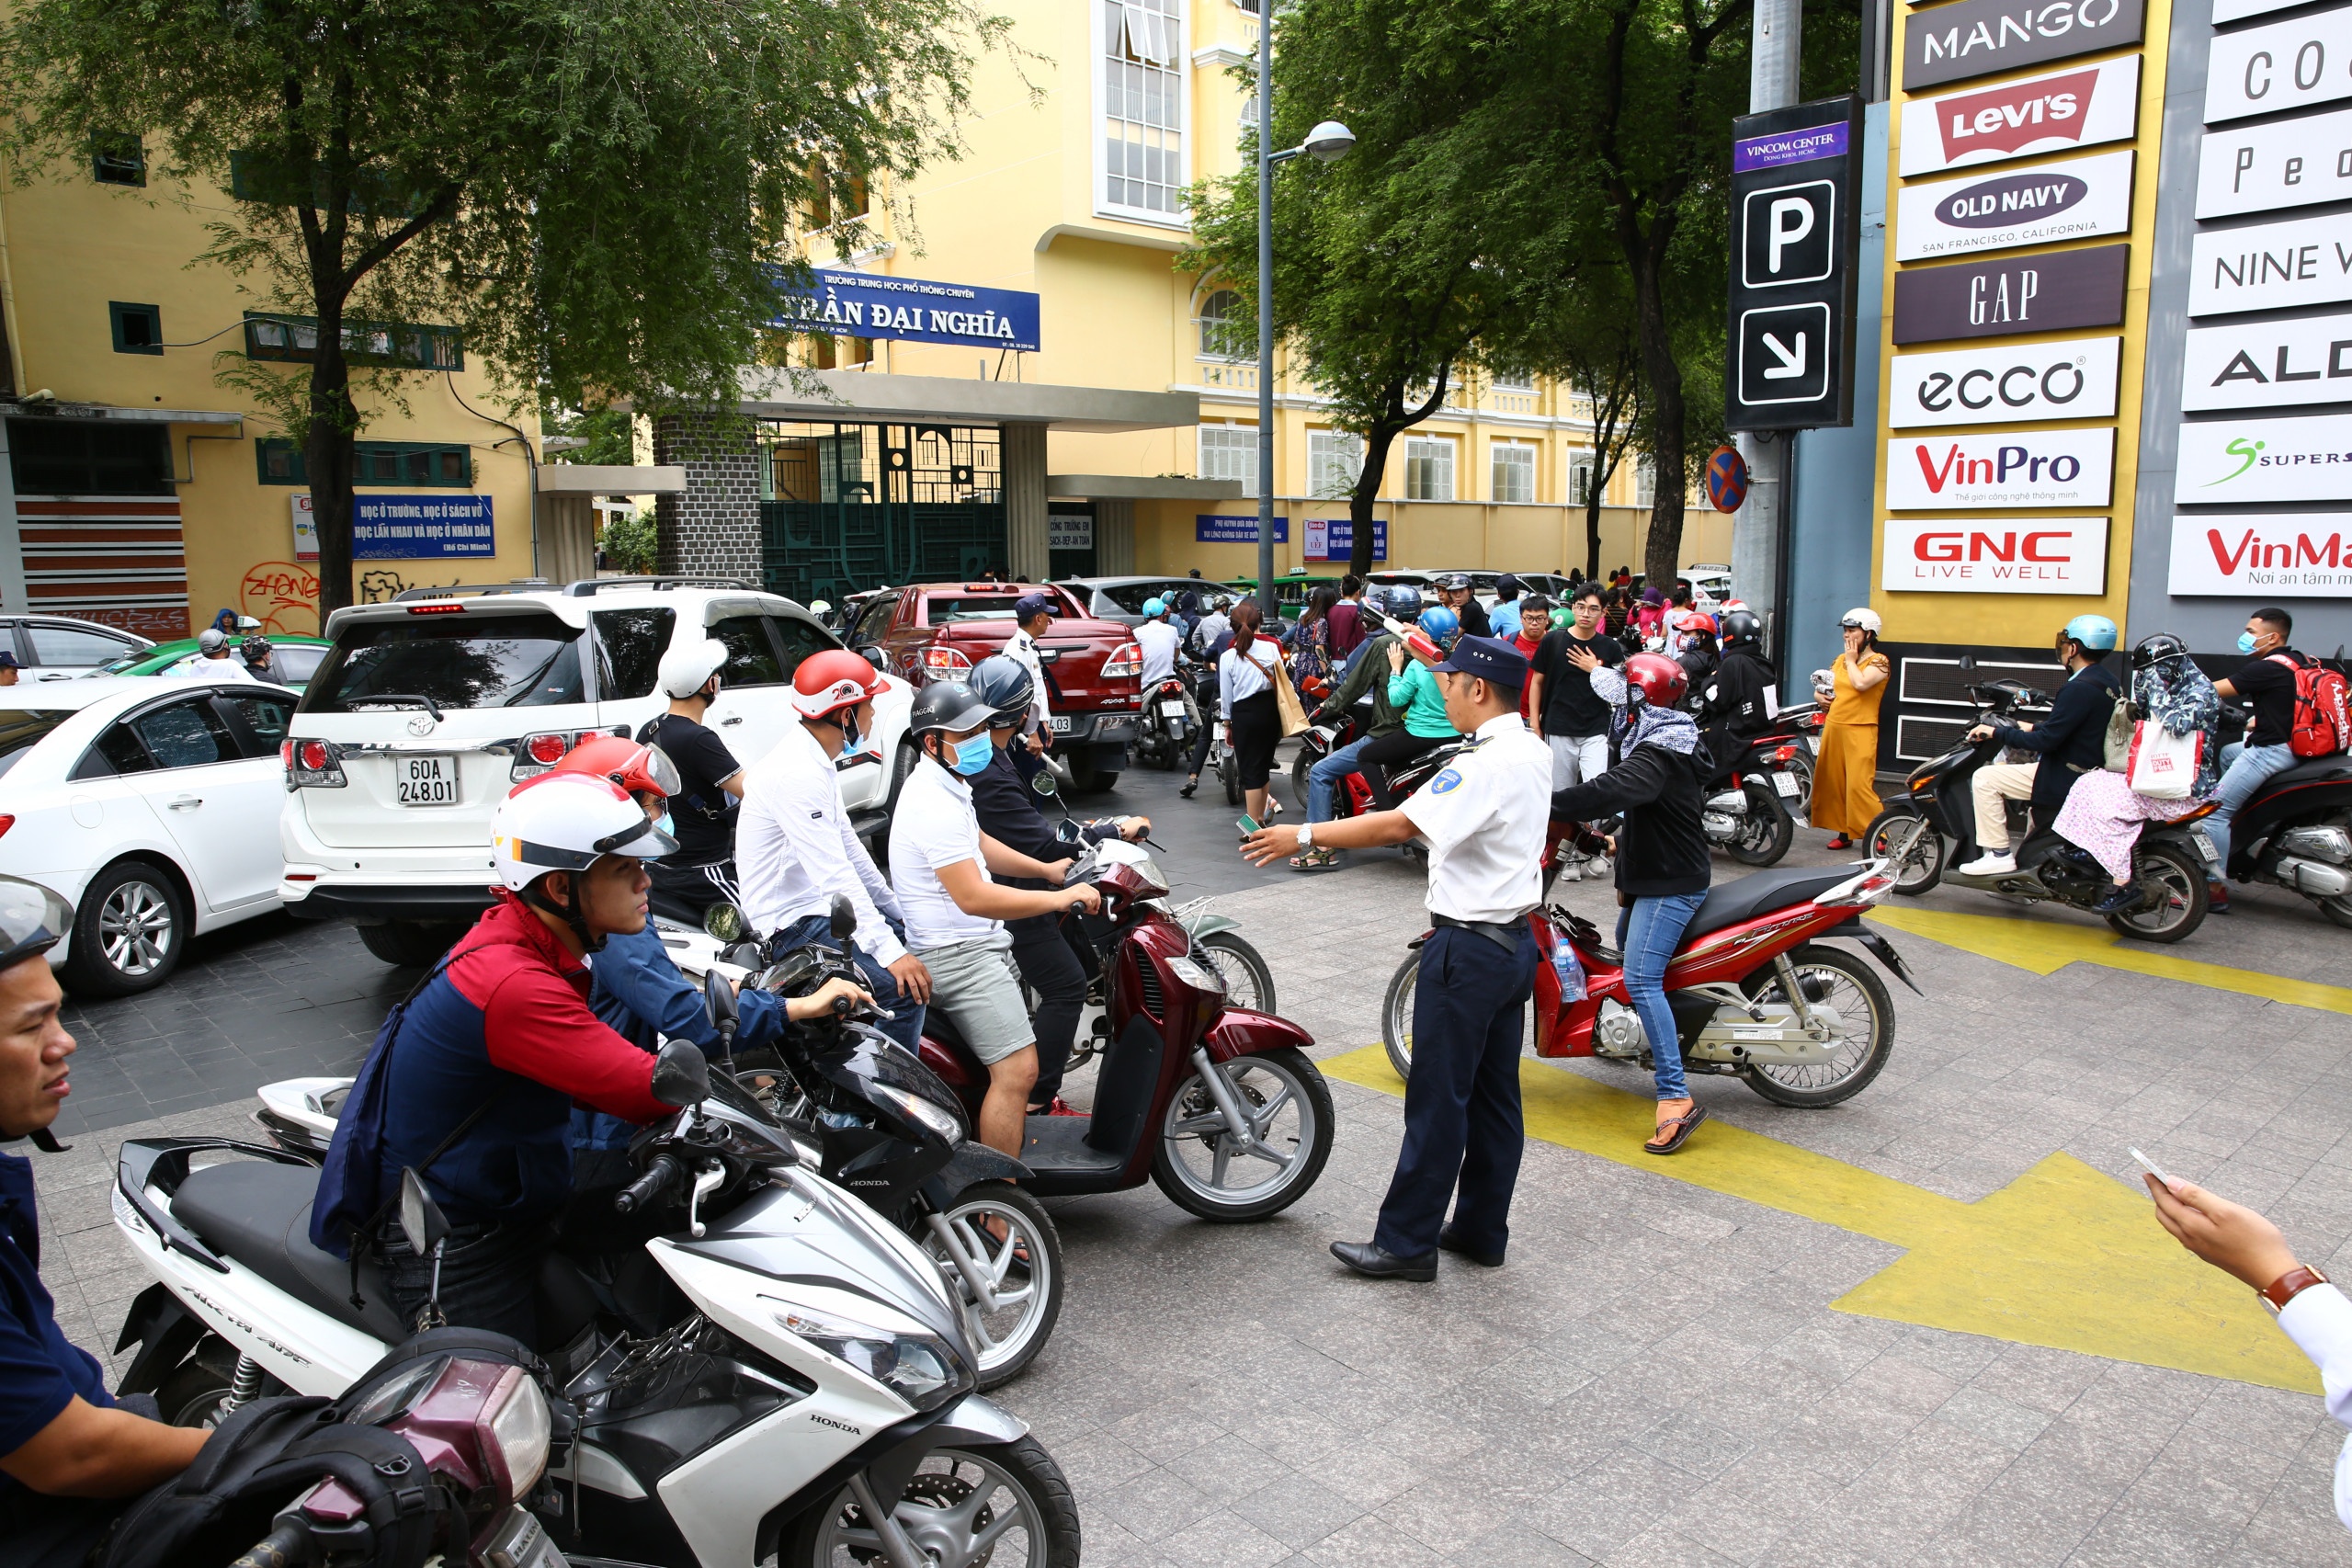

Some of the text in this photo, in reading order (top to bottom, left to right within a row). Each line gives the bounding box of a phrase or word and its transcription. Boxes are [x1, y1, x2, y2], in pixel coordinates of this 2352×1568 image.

[1924, 0, 2119, 64] MANGO
[2244, 40, 2352, 100] CO
[1747, 133, 1835, 157] VINCOM CENTER
[1764, 153, 1781, 162] DONG
[1798, 148, 1817, 156] HCMC
[1951, 183, 2069, 219] OLD NAVY
[1769, 197, 1814, 274] P
[1922, 222, 2097, 253] SAN FRANCISCO, CALIFORNIA
[2215, 244, 2319, 290] NINE
[858, 278, 882, 289] TRUNG
[884, 281, 902, 292] HỌC
[947, 289, 974, 300] CHUYÊN
[1969, 269, 2039, 325] GAP
[870, 303, 923, 335] ĐẠI
[929, 309, 1016, 339] NGHĨA
[1918, 362, 2085, 412] ecco
[1915, 443, 2081, 494] VinPro
[1955, 491, 2079, 502] Thế giới công nghệ thông minh
[360, 501, 483, 520] HỌC Ở TRƯỜNG, HỌC Ở SÁCH VỞ
[355, 522, 491, 540] HỌC LẪN NHAU VÀ HỌC Ở NHÂN DÂN
[1914, 531, 2073, 562] GNC
[1915, 565, 2070, 579] LIVE WELL
[2248, 572, 2274, 585] Nơi
[2278, 574, 2297, 585] an
[2303, 572, 2332, 585] tâm
[912, 705, 936, 718] PIAGGIO
[410, 759, 441, 780] 60A
[2153, 758, 2170, 767] DUTY
[400, 780, 452, 802] 248.01
[810, 1414, 861, 1436] HONDA
